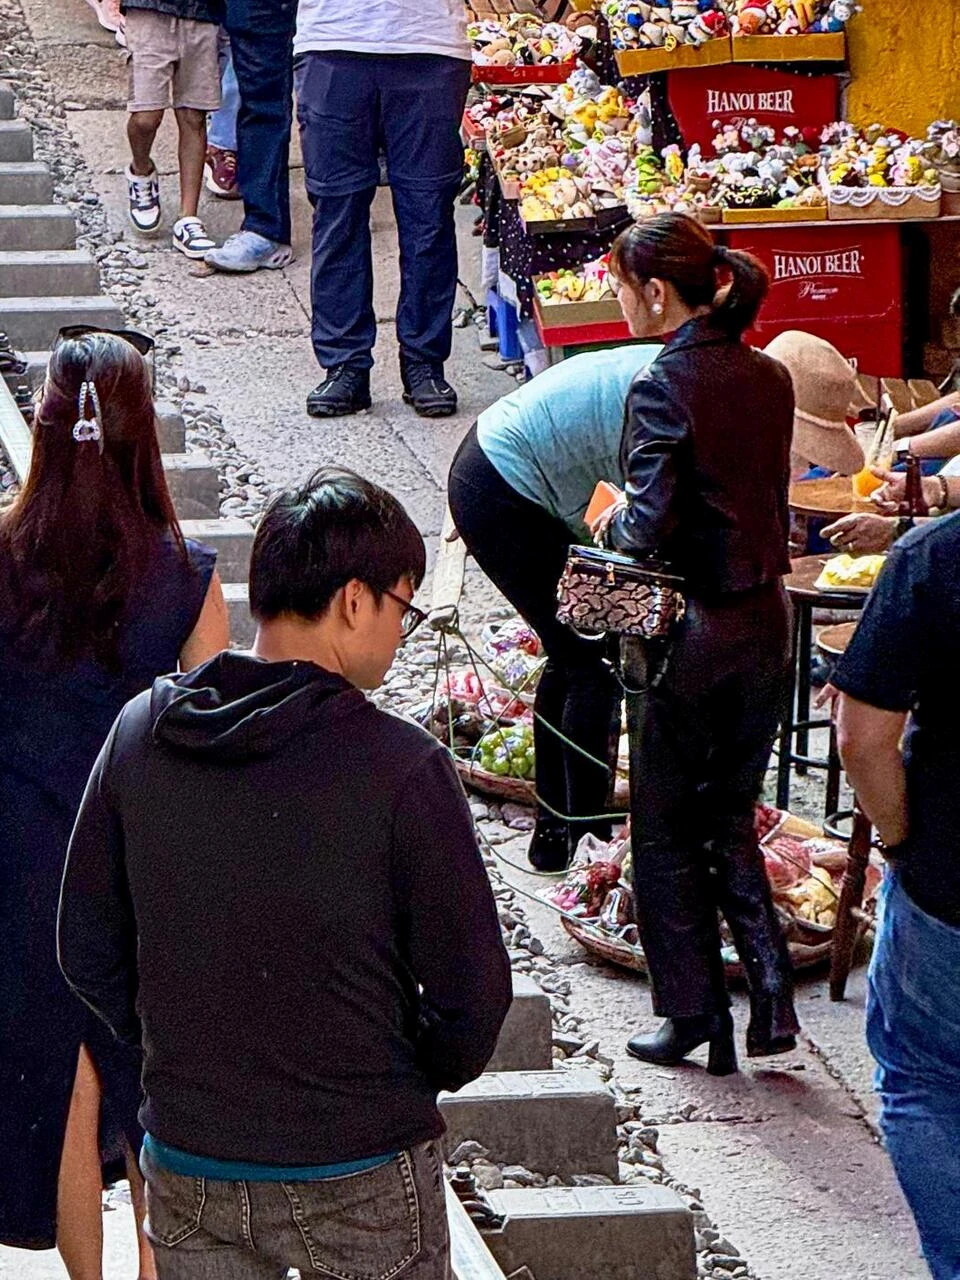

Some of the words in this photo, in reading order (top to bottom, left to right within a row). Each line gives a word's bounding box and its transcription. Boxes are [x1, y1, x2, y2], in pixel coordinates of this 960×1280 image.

[706, 89, 756, 114] HANOI
[757, 89, 795, 114] BEER
[773, 255, 822, 280] HANOI
[824, 250, 862, 274] BEER
